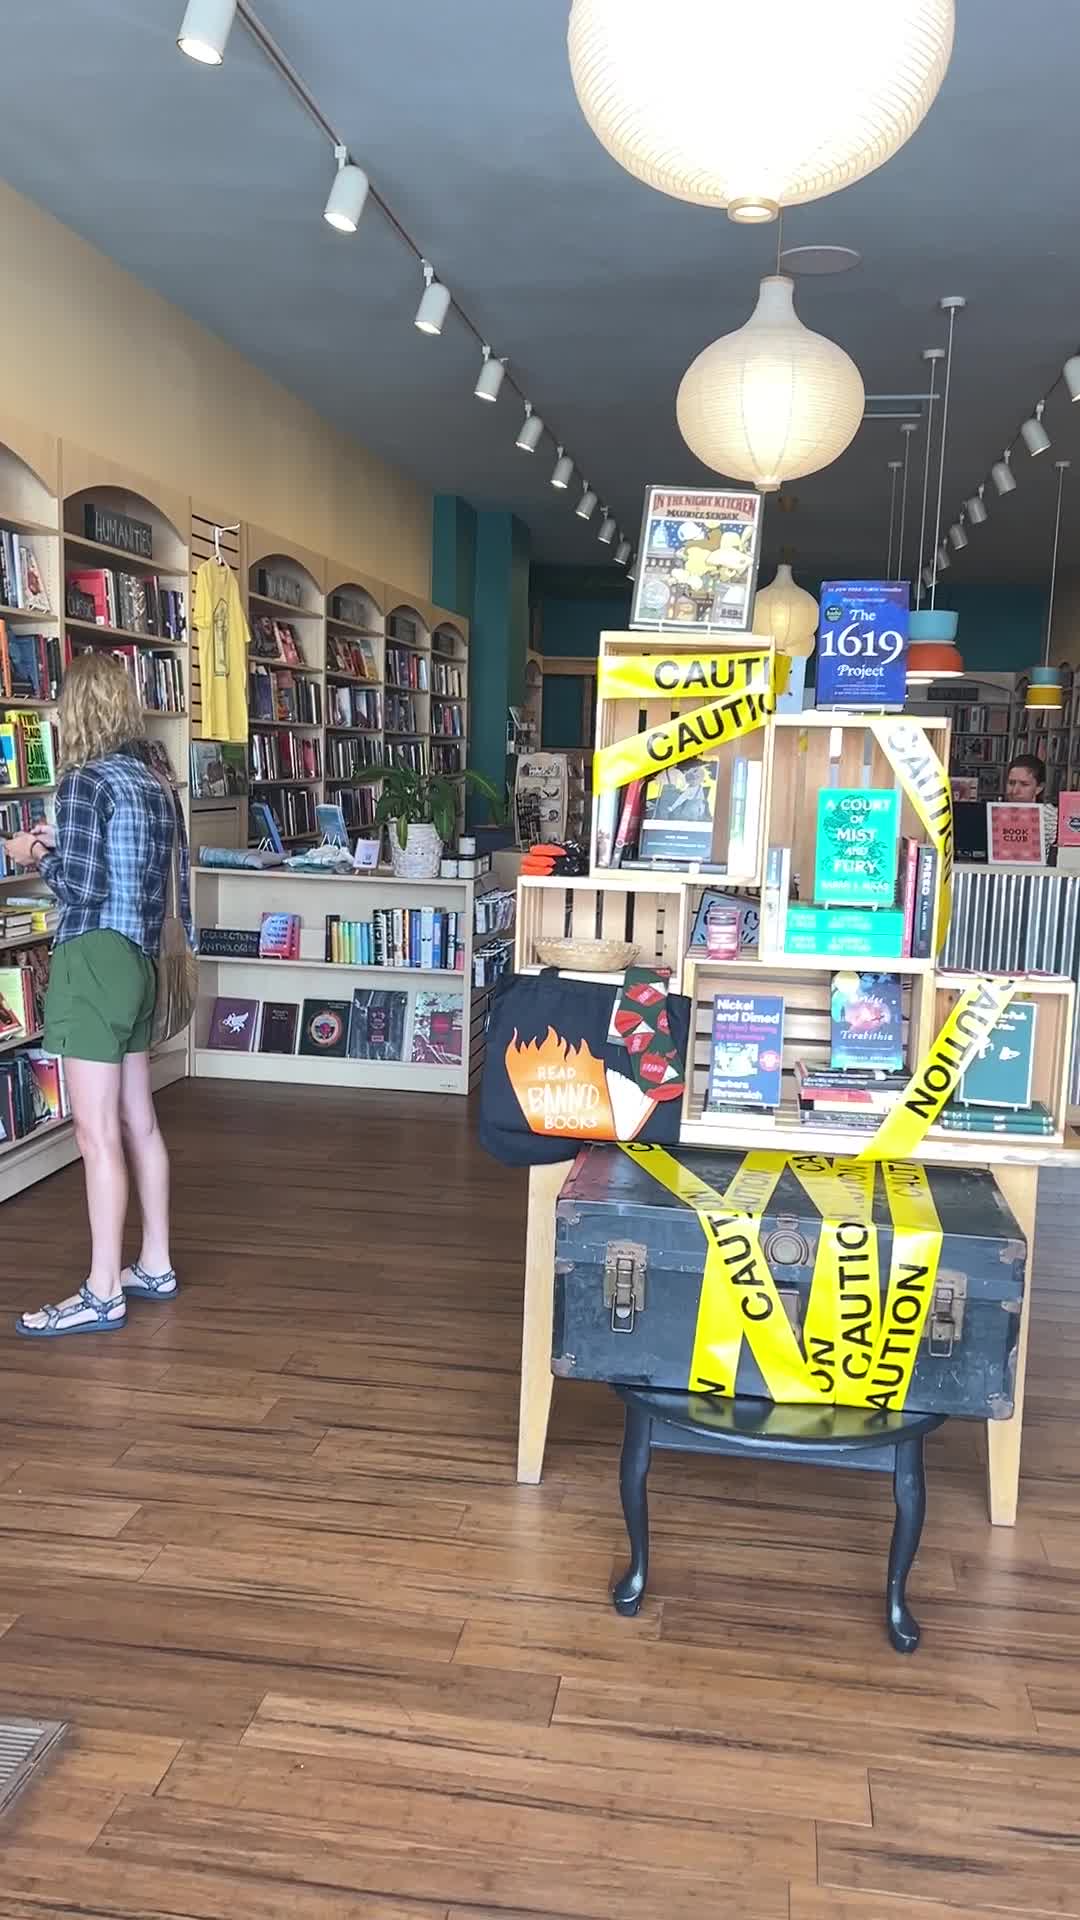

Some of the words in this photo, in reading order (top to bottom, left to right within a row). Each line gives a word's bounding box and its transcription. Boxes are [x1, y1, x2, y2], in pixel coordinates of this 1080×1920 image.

[667, 496, 683, 506] THE
[684, 496, 713, 506] NIGHT
[715, 497, 755, 517] KITCHEN
[666, 509, 704, 519] MAURICE
[95, 511, 152, 556] HUMANITIES
[848, 609, 877, 621] The
[820, 622, 904, 665] 1619
[837, 664, 885, 680] Project
[841, 799, 891, 811] COURT
[850, 815, 865, 823] OF
[836, 828, 877, 841] MIST
[844, 847, 868, 856] AND
[833, 860, 877, 873] FURY
[717, 999, 755, 1010] Nickel
[716, 1012, 739, 1022] and
[741, 1012, 780, 1024] Dimed
[841, 1030, 894, 1041] Terabithia
[537, 1066, 576, 1080] READ
[544, 1115, 597, 1129] BOOKS
[865, 1263, 929, 1411] AUTION
